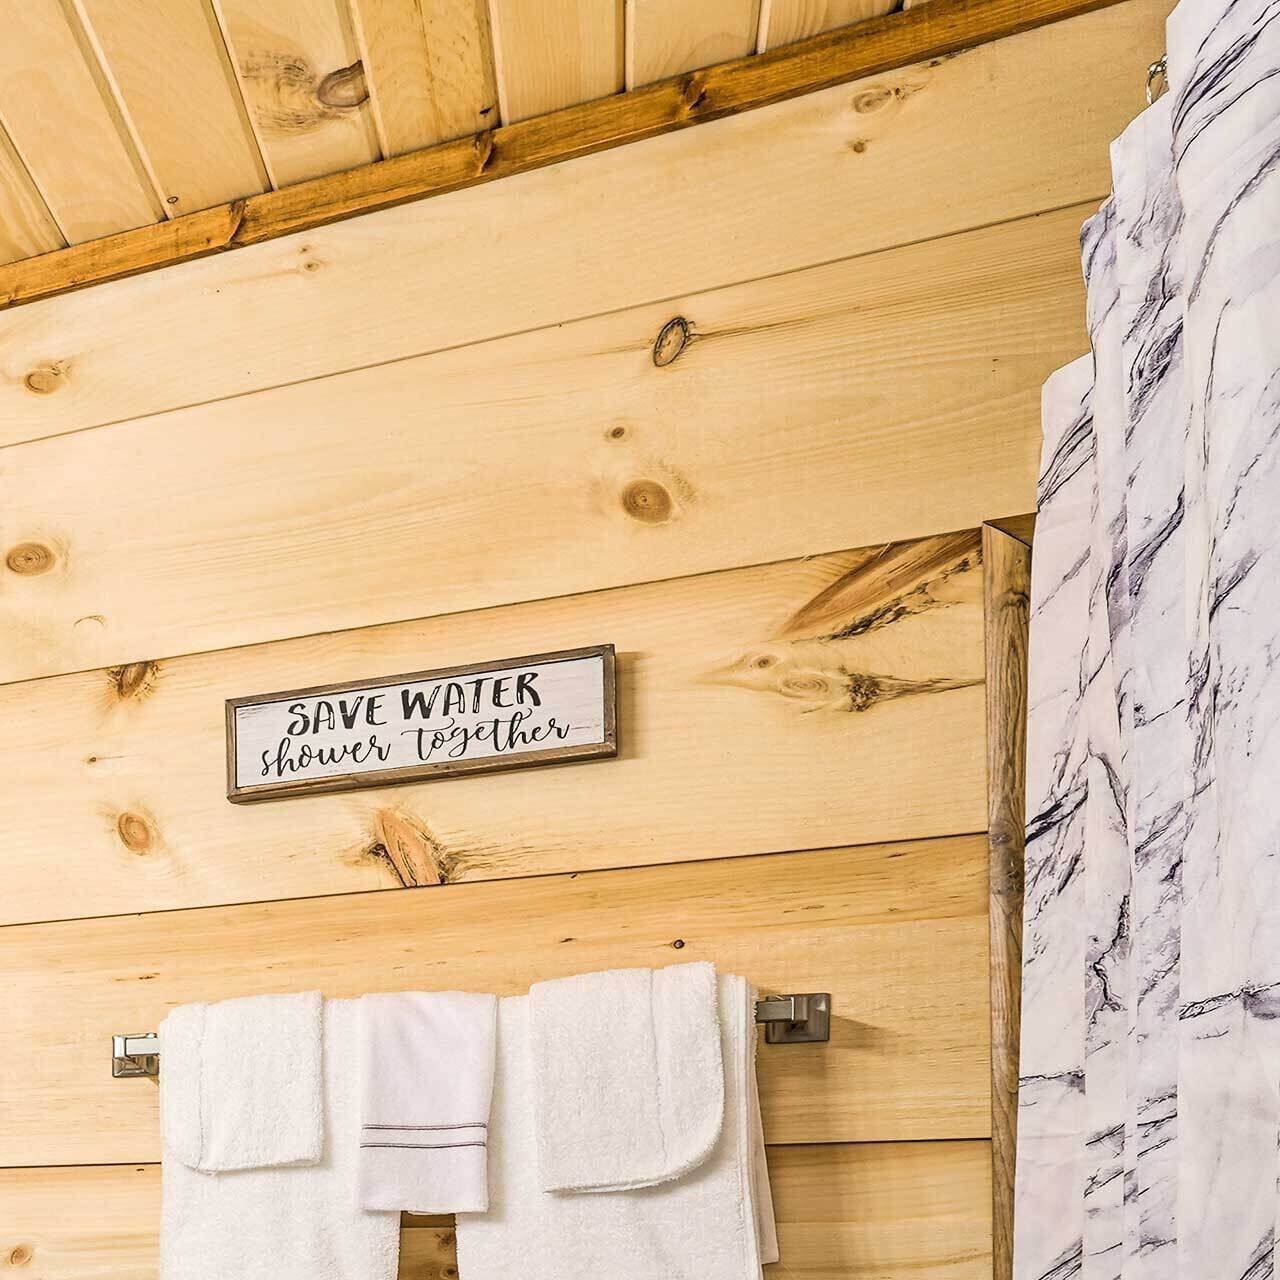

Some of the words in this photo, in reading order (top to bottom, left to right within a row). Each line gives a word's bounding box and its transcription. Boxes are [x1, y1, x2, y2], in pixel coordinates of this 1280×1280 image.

[287, 694, 387, 736] SAVE
[401, 672, 541, 720] WATER
[261, 737, 391, 777] shower
[401, 707, 570, 761] together
